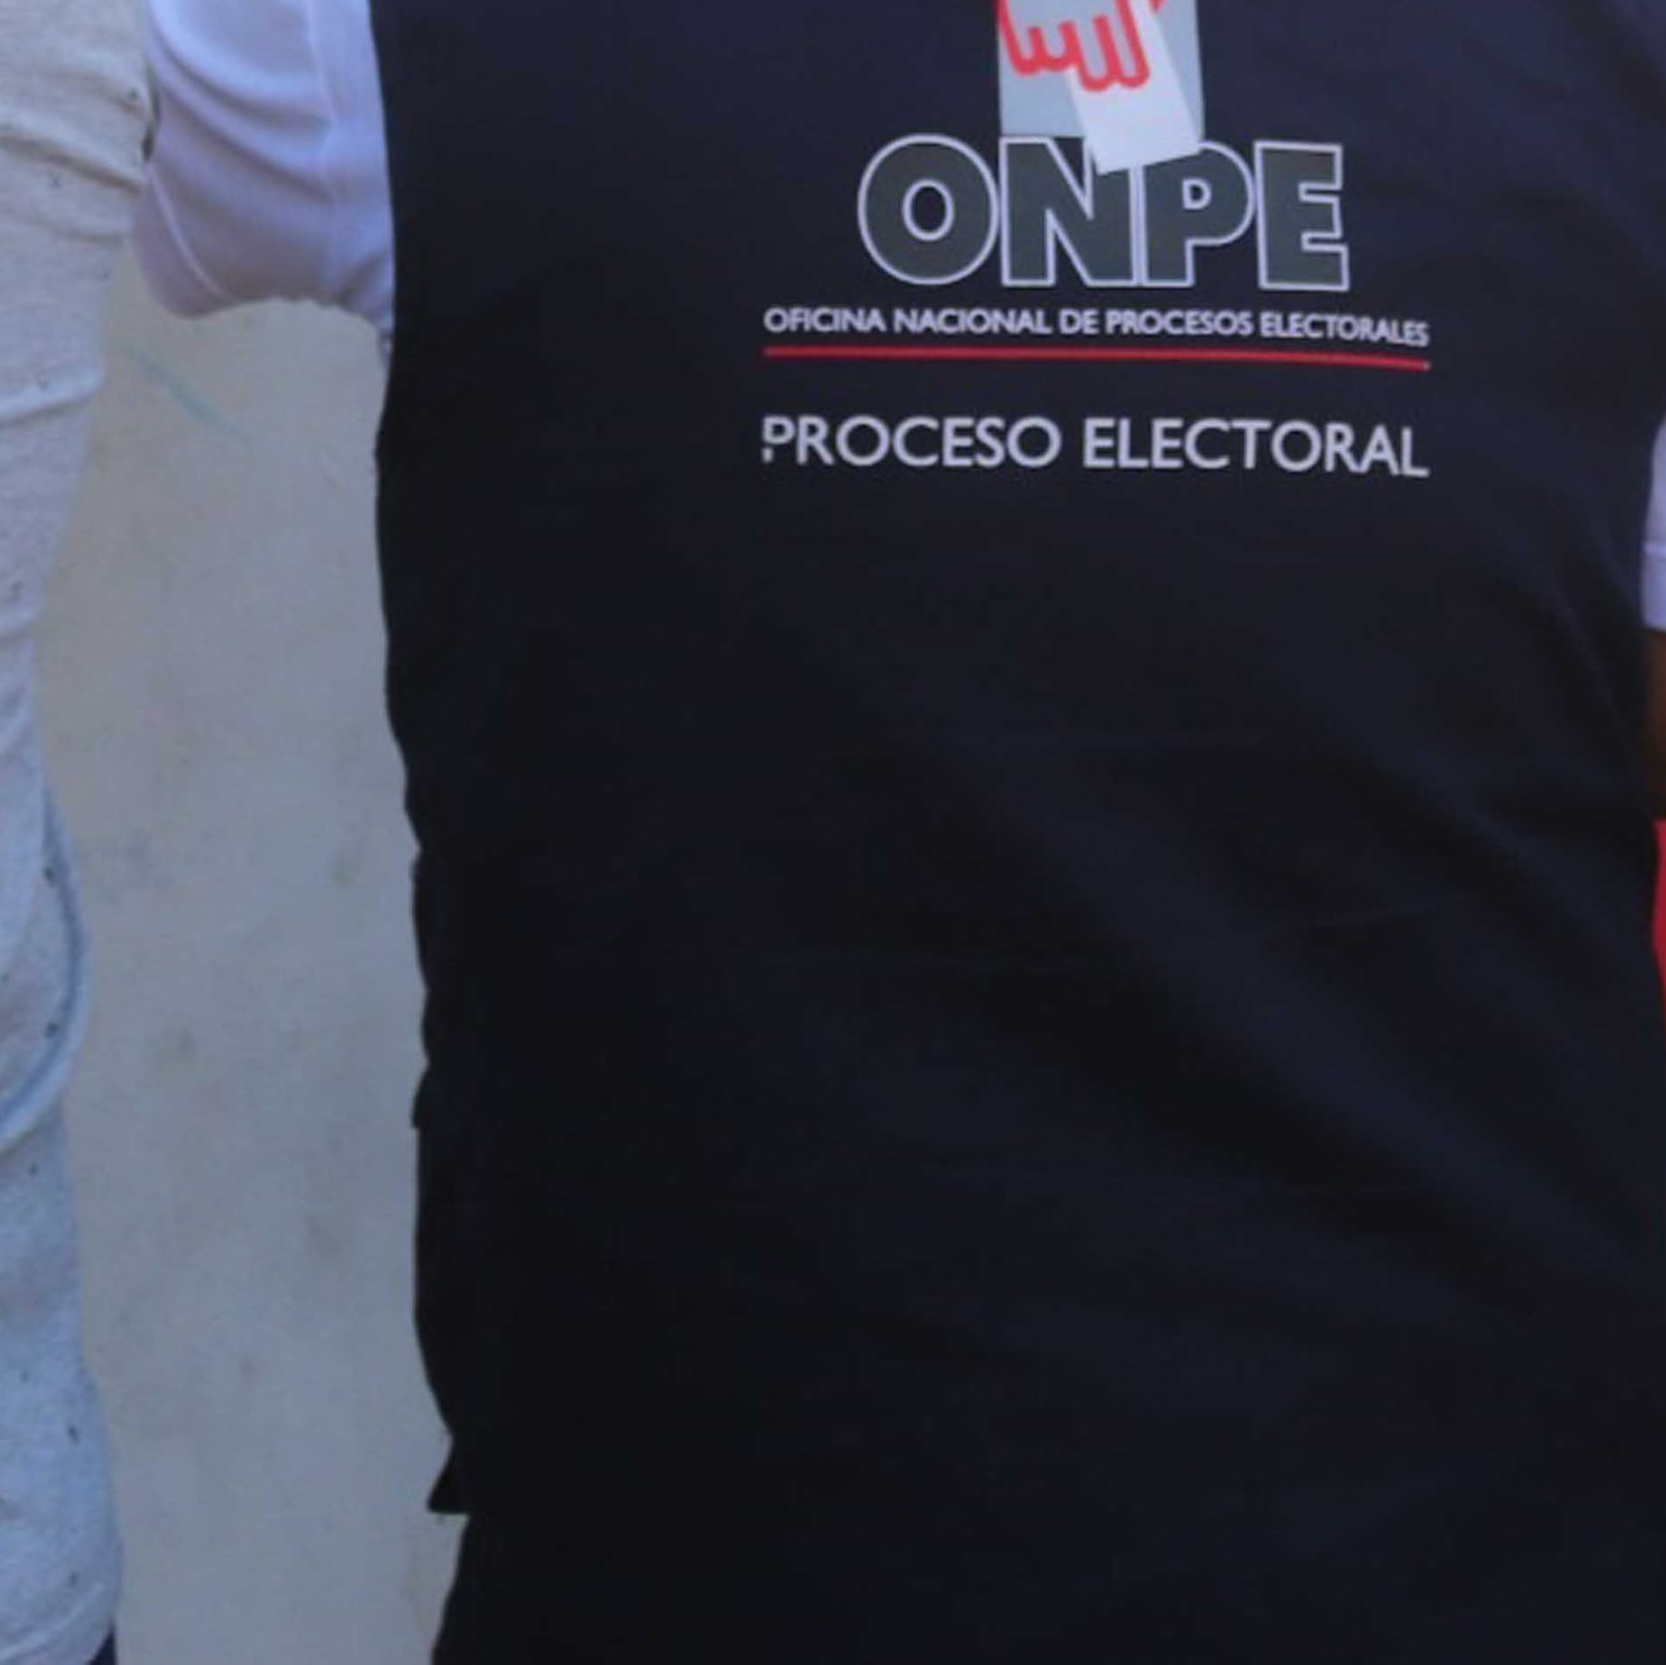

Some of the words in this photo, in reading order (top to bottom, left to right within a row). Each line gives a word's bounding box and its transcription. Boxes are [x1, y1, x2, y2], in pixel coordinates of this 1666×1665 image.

[857, 133, 1349, 292] ONPE
[763, 306, 887, 333] OFICINA
[893, 307, 1053, 335] NACIONAL
[1058, 308, 1099, 335] DE
[1104, 309, 1255, 336] PROCESOS
[1259, 312, 1430, 348] ELECTORALES
[761, 414, 1062, 467] PROCESO
[1083, 416, 1430, 478] ELECTORAL
